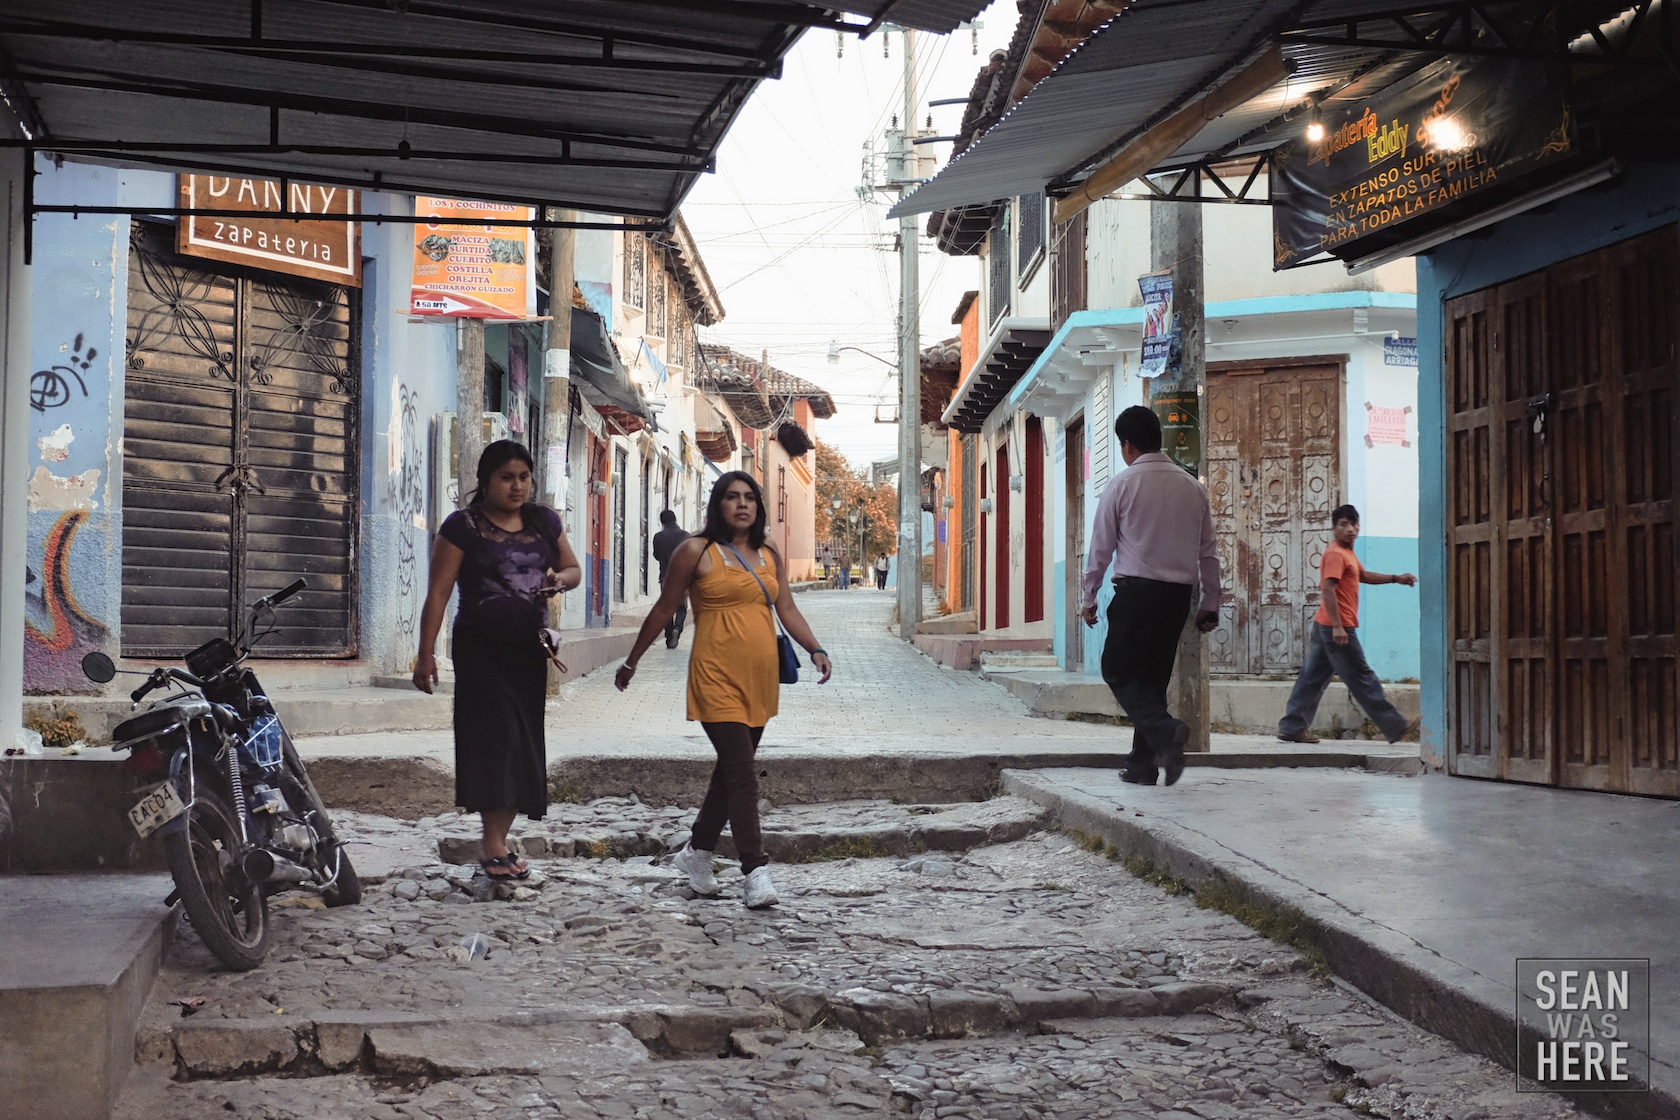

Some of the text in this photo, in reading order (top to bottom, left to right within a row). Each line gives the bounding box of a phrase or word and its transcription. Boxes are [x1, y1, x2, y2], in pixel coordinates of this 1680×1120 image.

[1367, 118, 1410, 163] Eddy
[1329, 133, 1477, 209] EXTENSO SURTO
[208, 175, 336, 214] DANNY
[1325, 150, 1487, 229] EN ZAPATOS DE PIEL
[429, 199, 448, 207] LOS
[456, 201, 516, 212] COCHINITOS
[1320, 167, 1498, 249] PARA TODA LA FAMILIA
[452, 235, 490, 245] MACIZA
[449, 244, 493, 255] SURTIDA
[449, 255, 492, 264] CUERITO
[446, 265, 494, 274] COSTILLA
[448, 275, 491, 284] OREJITA
[424, 283, 477, 292] CHICHARRON
[1390, 338, 1418, 346] CALLE
